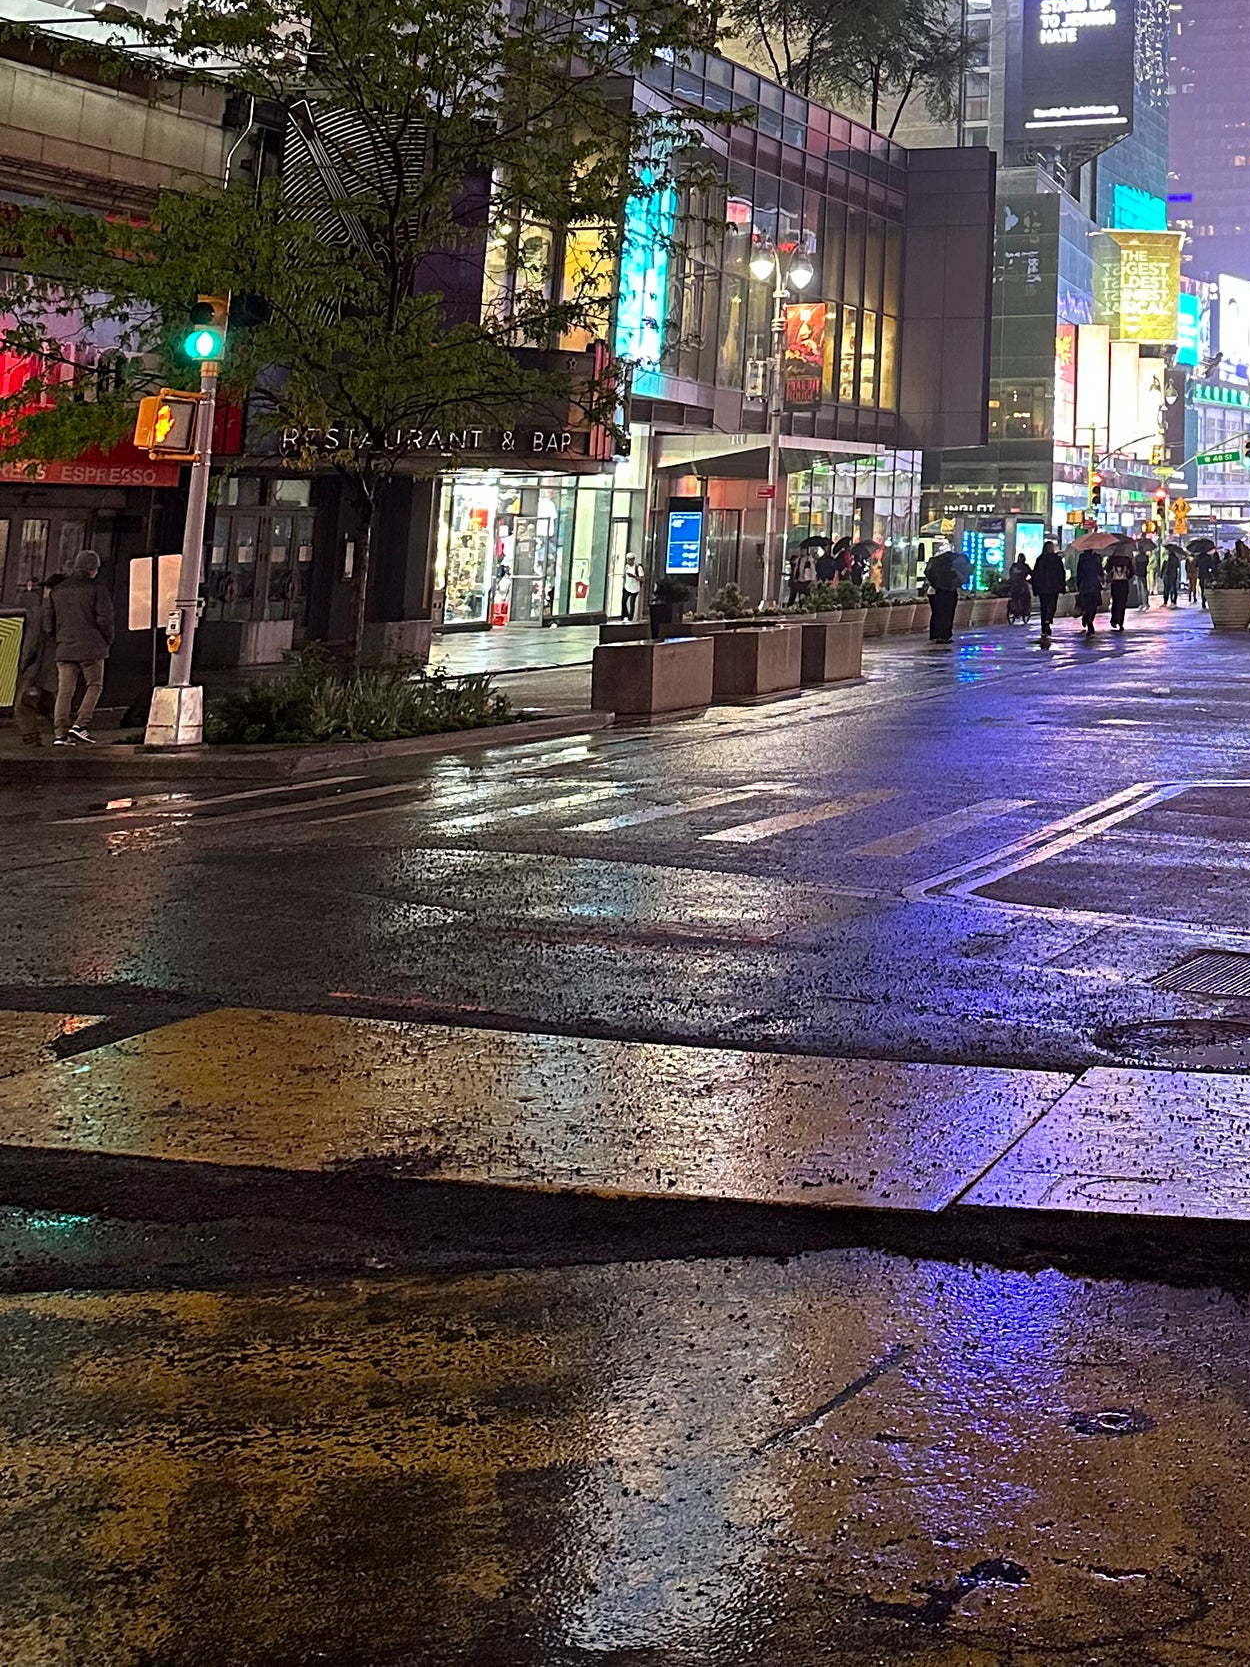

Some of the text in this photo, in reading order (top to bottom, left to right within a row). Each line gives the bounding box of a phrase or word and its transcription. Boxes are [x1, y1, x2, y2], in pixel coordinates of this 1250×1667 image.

[1040, 14, 1061, 29] TO
[1040, 29, 1078, 45] HATE
[1121, 250, 1148, 261] THE
[501, 430, 516, 451] &
[61, 465, 157, 484] ESPRESSO
